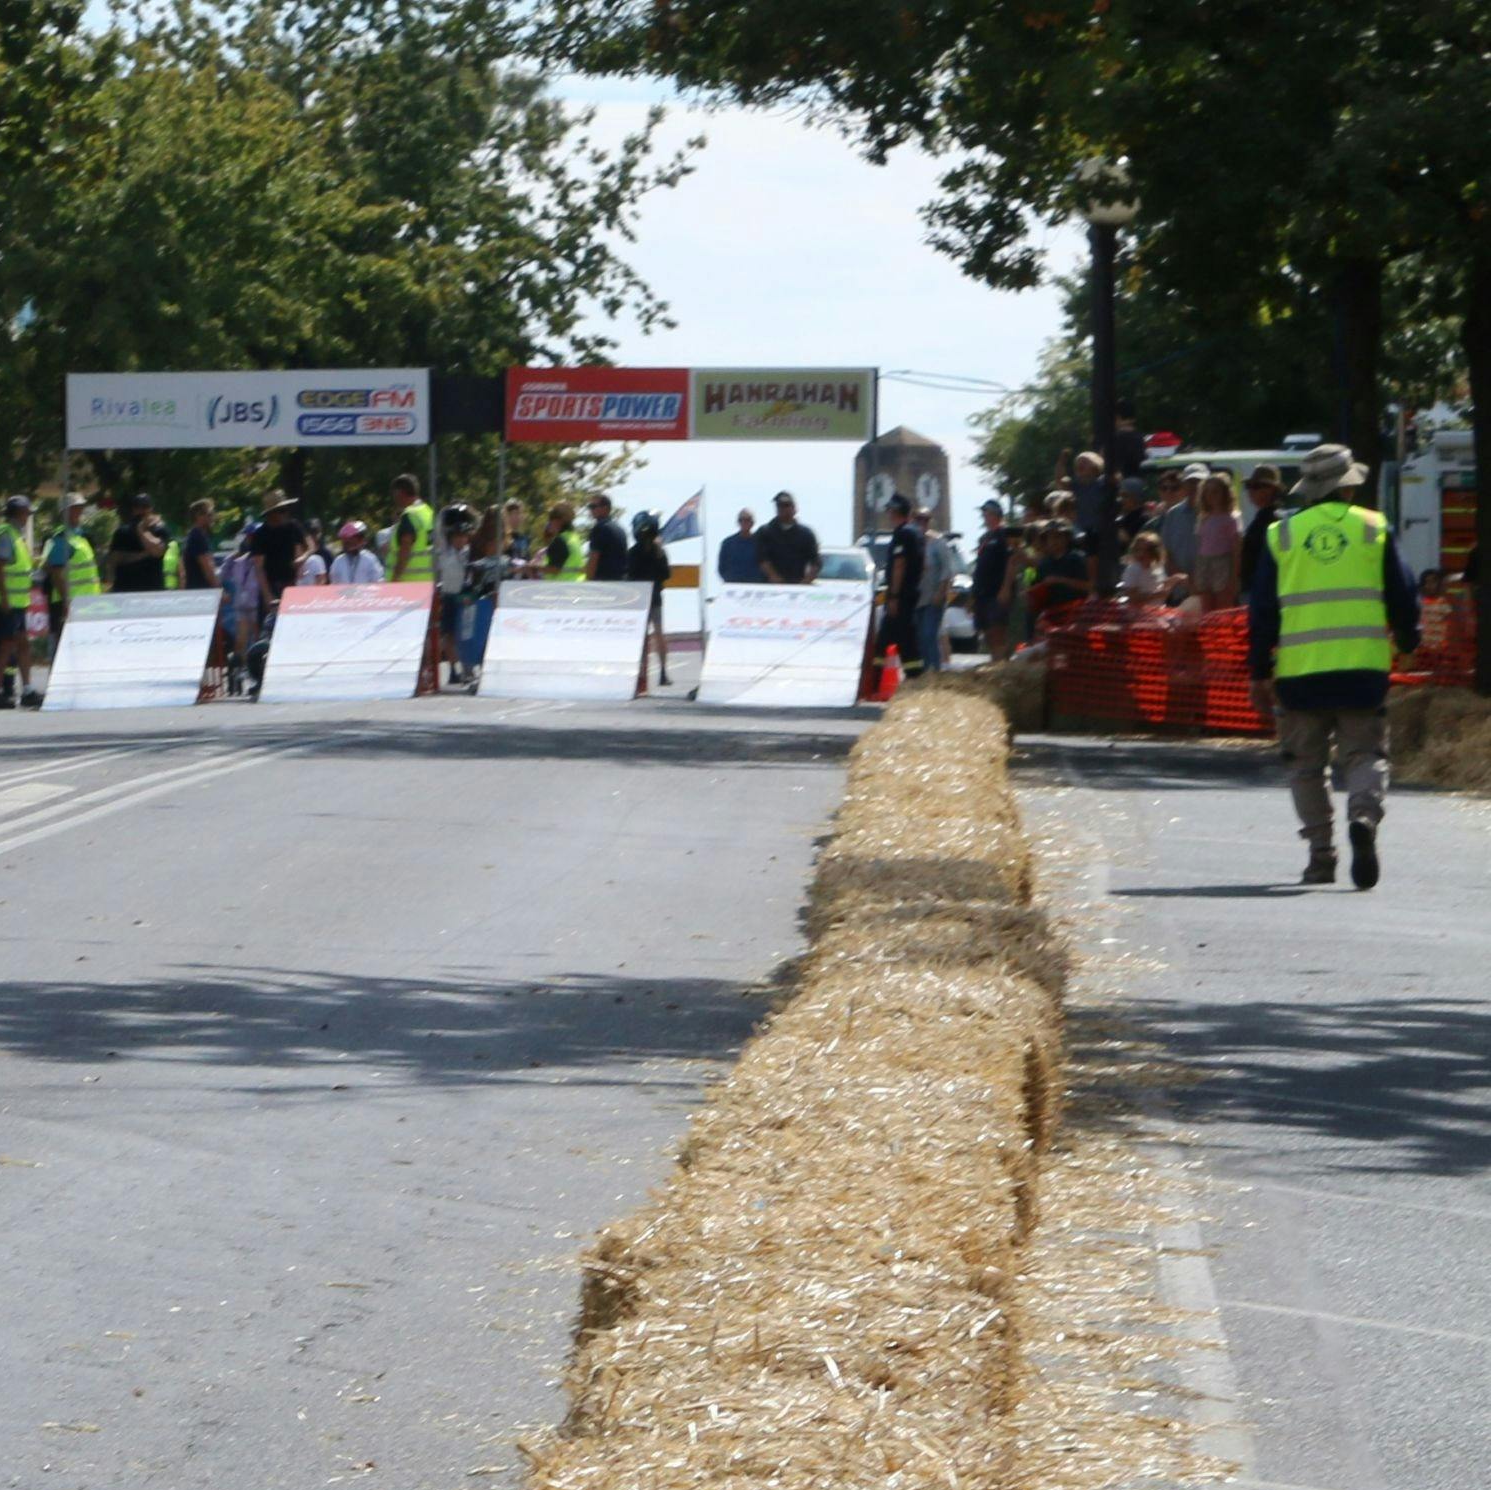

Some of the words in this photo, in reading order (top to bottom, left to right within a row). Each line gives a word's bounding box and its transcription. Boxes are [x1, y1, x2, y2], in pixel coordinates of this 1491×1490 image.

[90, 397, 177, 416] Rivalea
[371, 390, 416, 407] FM
[515, 393, 681, 419] SPORTSPOWER
[704, 382, 860, 414] HANRAHAN
